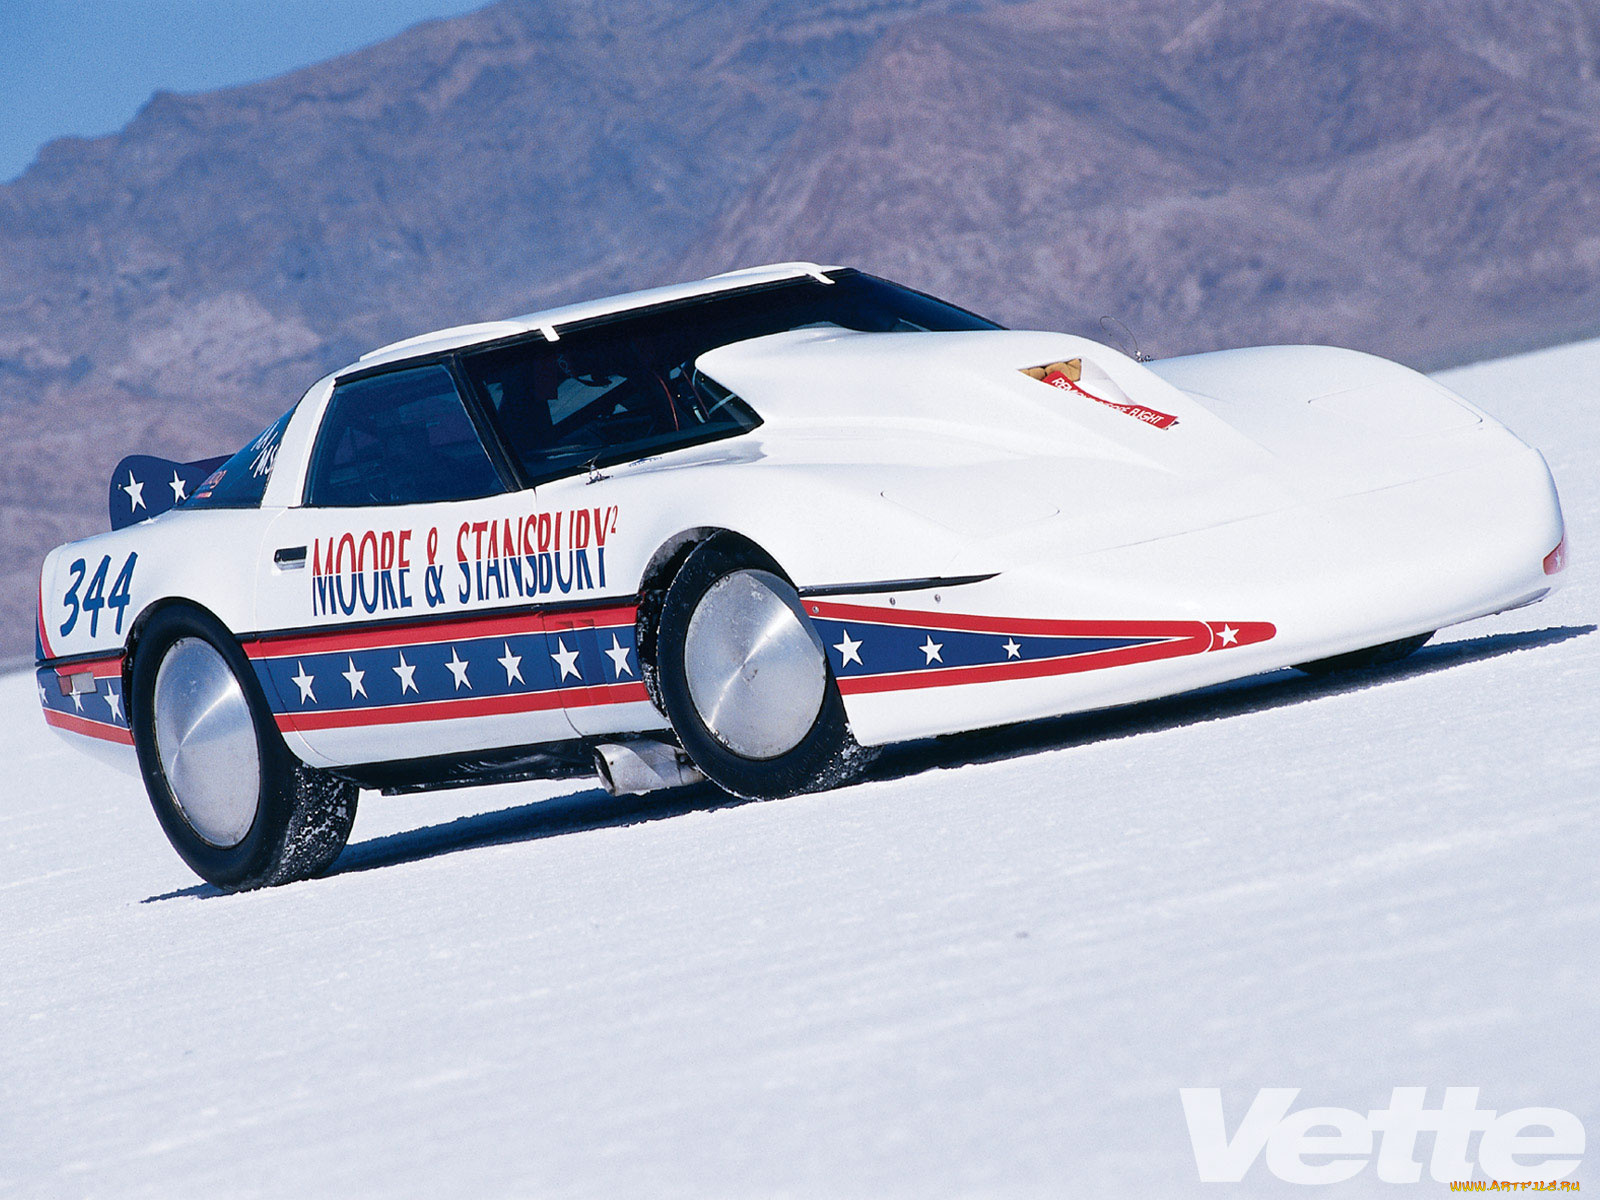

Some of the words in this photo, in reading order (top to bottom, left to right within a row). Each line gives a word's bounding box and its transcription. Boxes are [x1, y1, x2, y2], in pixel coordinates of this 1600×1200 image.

[59, 551, 139, 638] 344
[312, 529, 412, 617] MOORE
[424, 527, 446, 608] &
